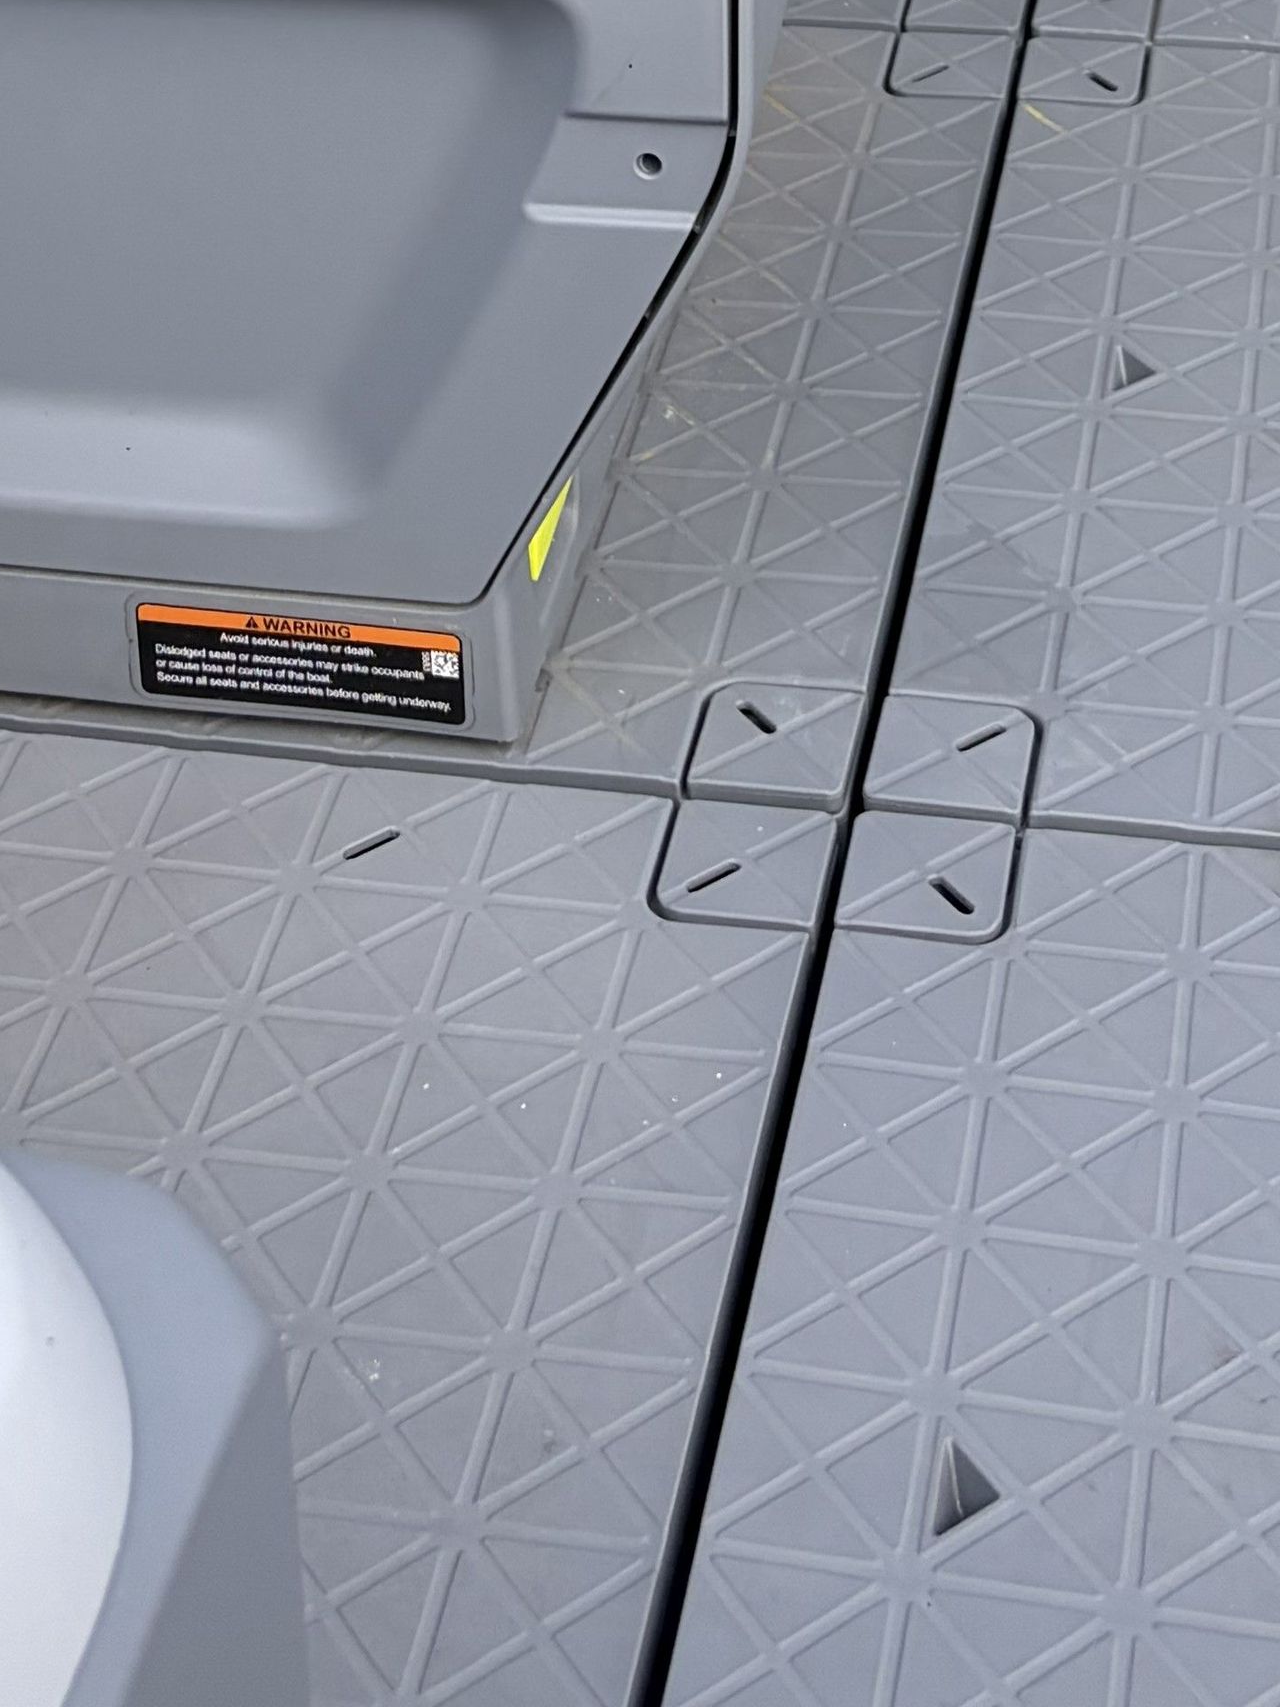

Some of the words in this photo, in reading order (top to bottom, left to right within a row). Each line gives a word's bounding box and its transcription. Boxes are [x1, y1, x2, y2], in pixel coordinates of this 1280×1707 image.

[263, 617, 351, 639] WARNING
[220, 632, 249, 645] Avoid
[251, 637, 289, 649] serious
[291, 638, 329, 654] injuries
[330, 644, 342, 653] or
[344, 645, 377, 658] death.
[155, 643, 206, 659] Dislodged
[208, 650, 236, 661] seats
[238, 652, 250, 661] or
[252, 654, 314, 669] accessories
[315, 660, 339, 673] may
[341, 662, 369, 674] strike
[371, 666, 425, 681] occupants
[155, 658, 166, 667] or
[168, 660, 200, 671] cause
[201, 662, 223, 673] loss
[225, 663, 236, 674] of
[237, 665, 273, 678] control
[275, 668, 286, 678] of
[287, 670, 305, 681] the
[156, 670, 193, 684] Secure
[195, 675, 208, 685] all
[210, 677, 238, 689] seats
[240, 680, 260, 690] and
[262, 682, 324, 697] accessories
[326, 687, 360, 699] before
[361, 693, 397, 706] getting
[398, 695, 452, 713] underway.
